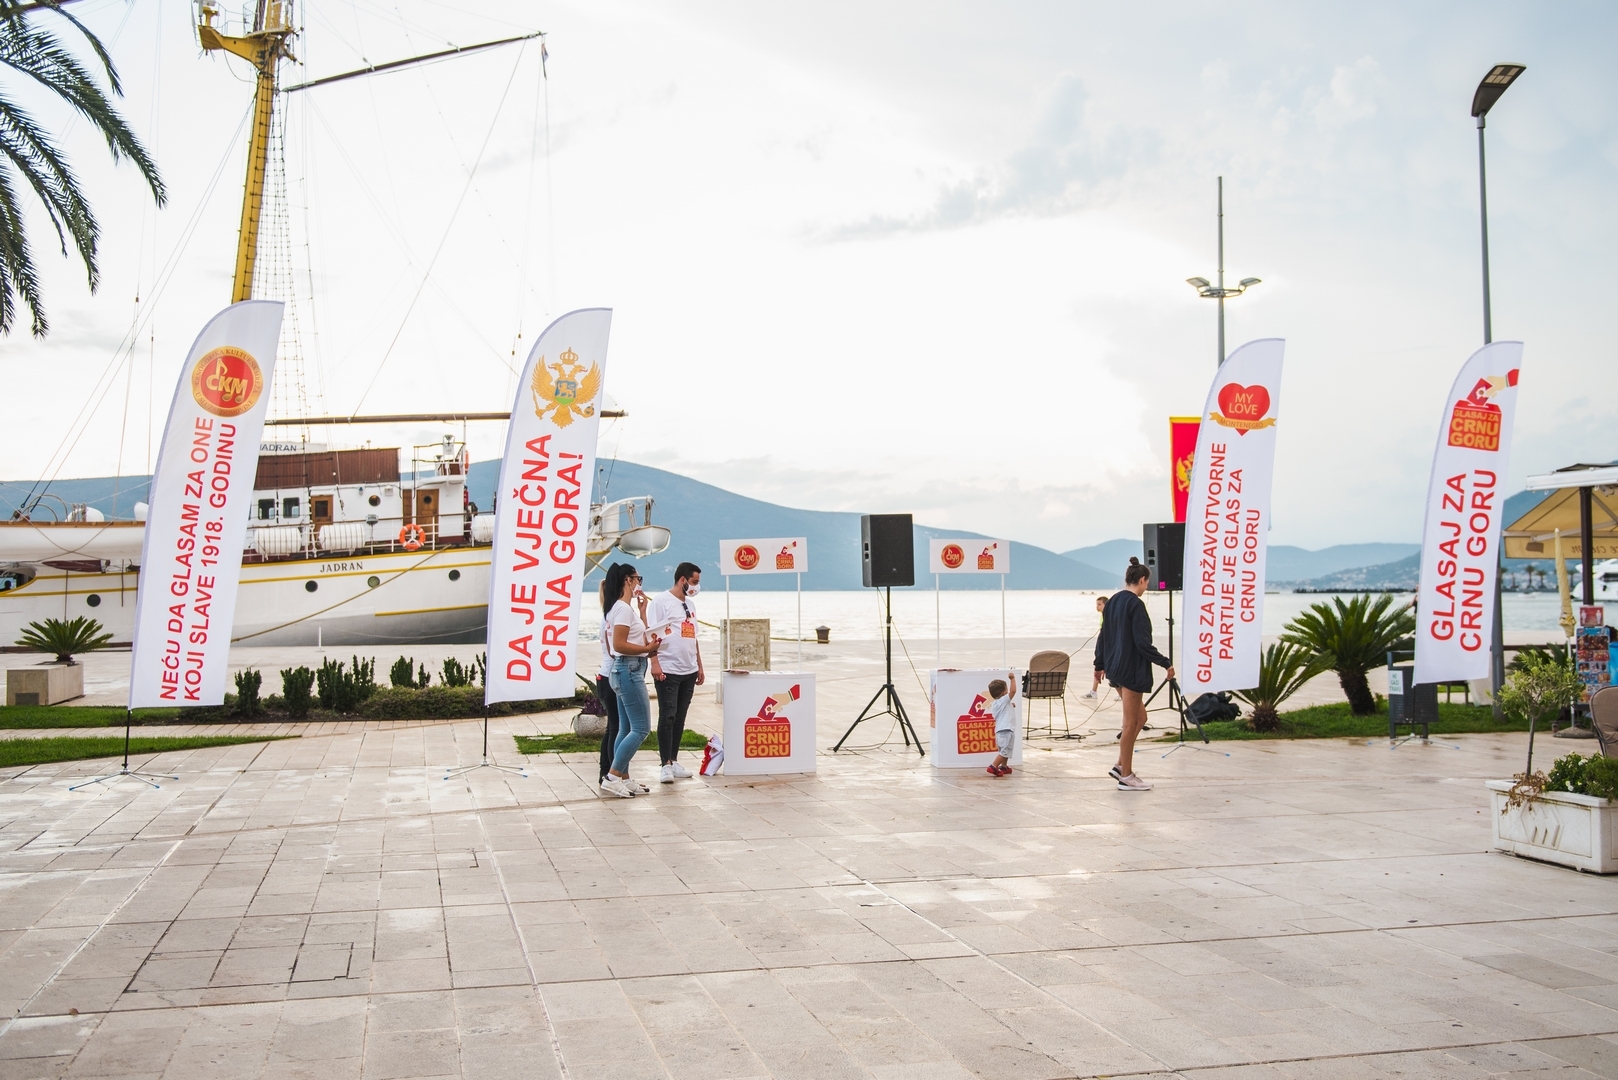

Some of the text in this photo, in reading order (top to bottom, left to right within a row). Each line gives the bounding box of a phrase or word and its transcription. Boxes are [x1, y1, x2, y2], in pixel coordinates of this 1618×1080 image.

[1234, 392, 1254, 404] MY
[1228, 402, 1258, 416] LOVE
[1453, 409, 1499, 422] GLASAJ ZA
[1220, 418, 1264, 429] MONTENEGRO
[1451, 417, 1499, 436] CRNU
[1450, 431, 1498, 450] GORU
[159, 417, 213, 701] NEĆU DA GLASAM ZA ONE
[184, 422, 237, 701] KOJI SLAVE 1918. GODINU
[505, 434, 552, 682] DA JE VJEČNA
[539, 451, 584, 673] CRNA GORA!
[1196, 443, 1227, 683] GLAS ZA DRŽAVOTVORNE
[1218, 469, 1243, 660] PARTIJE JE GLAS ZA
[1240, 509, 1261, 623] CRNU GORU
[1430, 473, 1467, 641] GLASAJ ZA
[1459, 469, 1497, 653] CRNU GORU
[320, 561, 364, 573] JADRAN
[746, 725, 777, 733] GLASAJ
[958, 721, 987, 730] GLASAJ
[746, 732, 790, 745] CRNU
[746, 744, 790, 757] GORU
